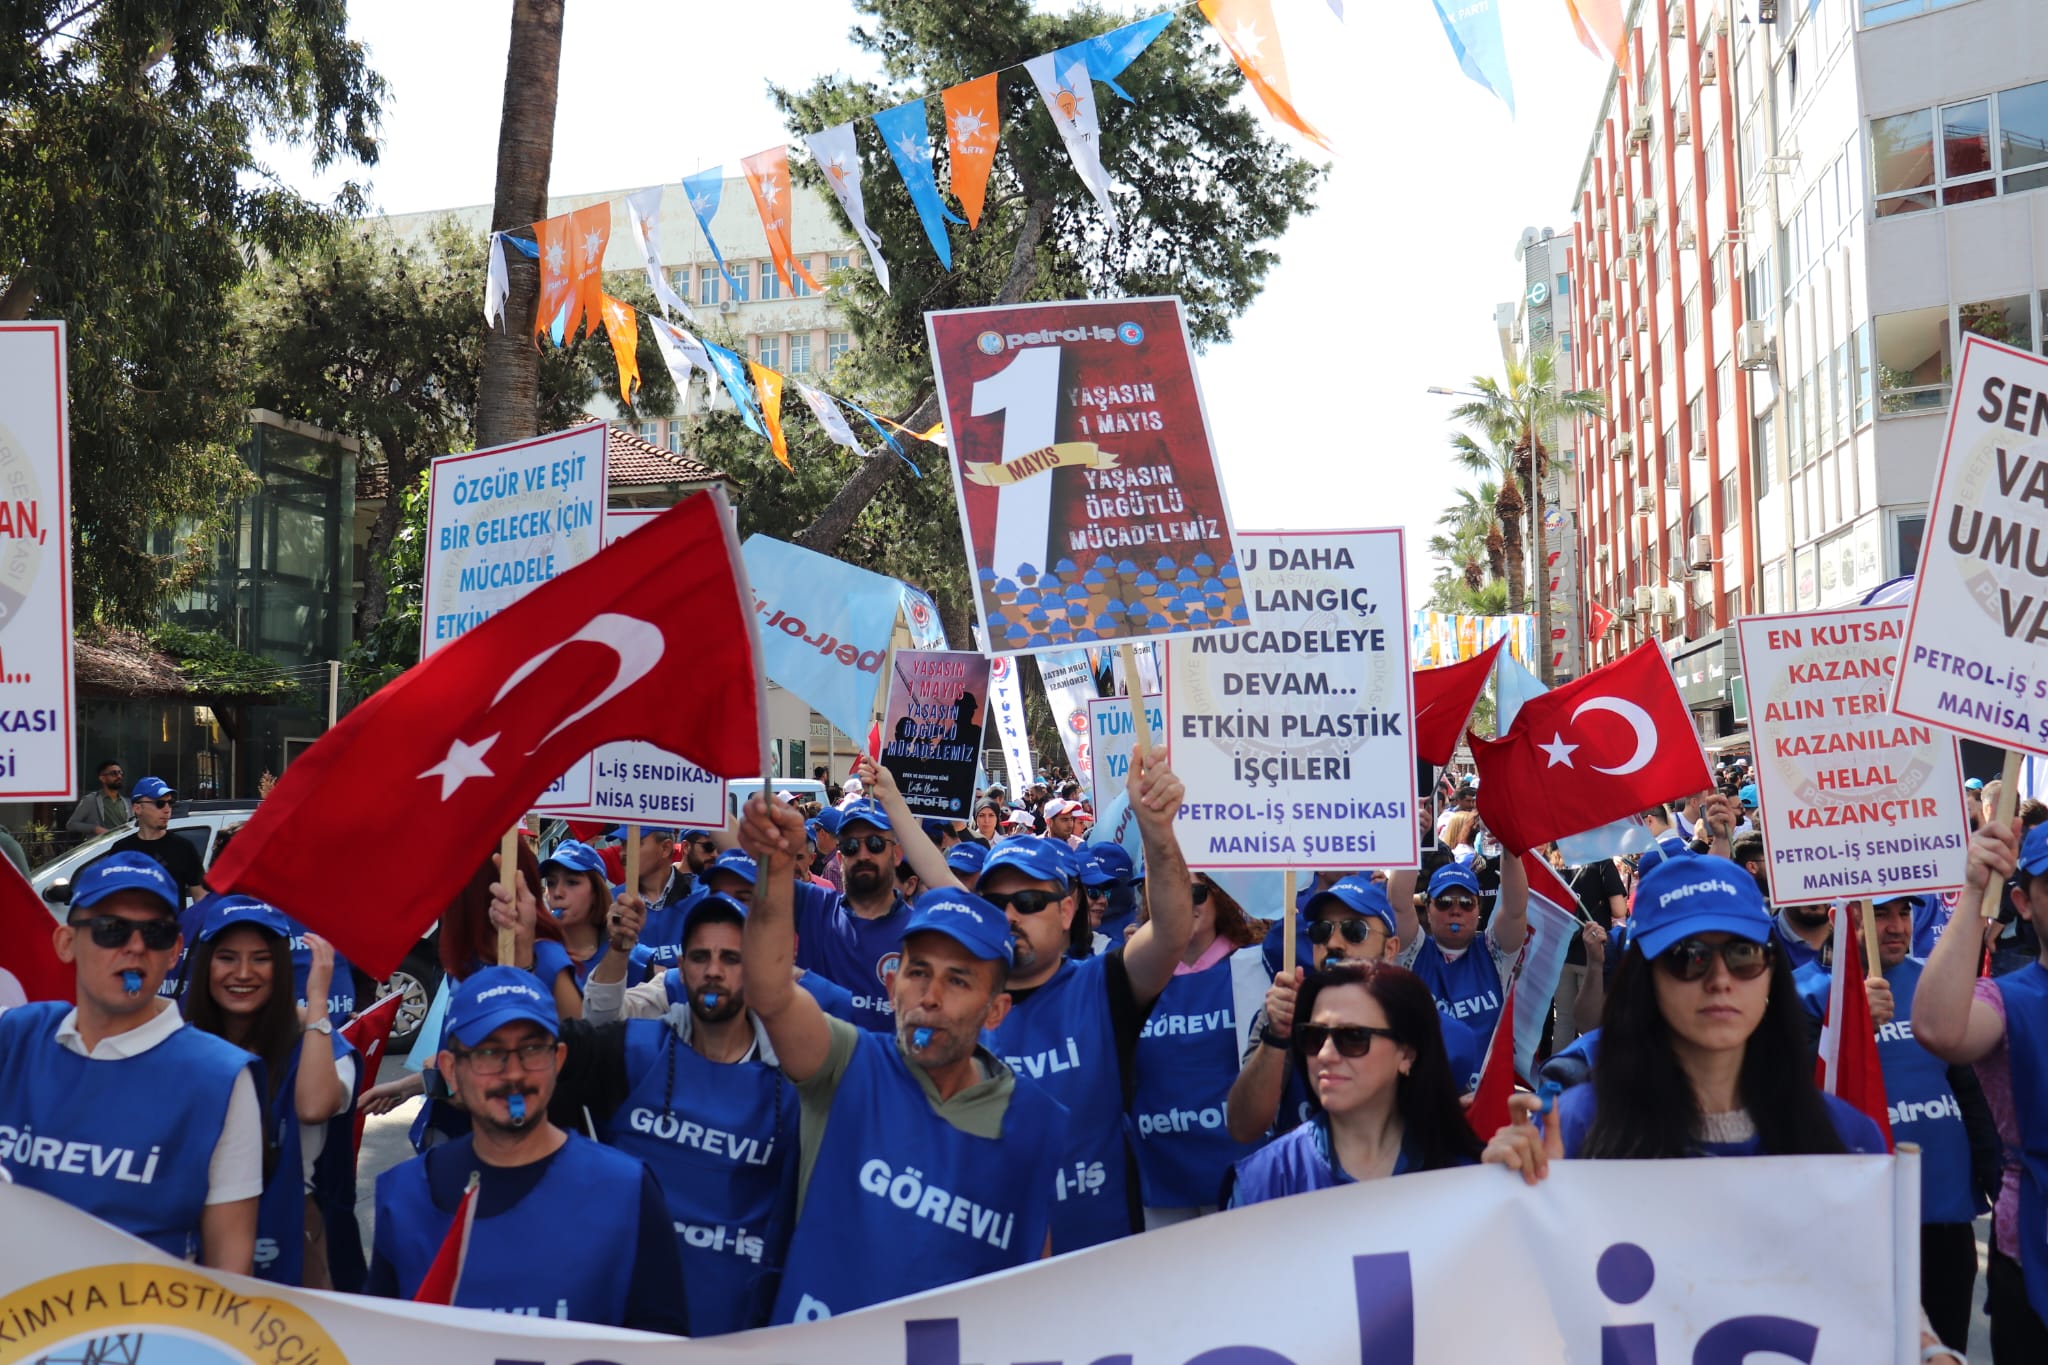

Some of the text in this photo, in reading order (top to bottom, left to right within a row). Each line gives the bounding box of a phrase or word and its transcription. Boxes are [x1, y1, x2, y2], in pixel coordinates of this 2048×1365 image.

[1005, 325, 1116, 350] petrol-iş
[1068, 384, 1156, 411] YAŞASIN
[1078, 411, 1163, 435] 1 MAYIS
[453, 450, 586, 506] ÖZGÜR VE EŞİT
[1005, 447, 1061, 482] MAYIS
[1083, 465, 1174, 493] YAŞASIN
[1086, 489, 1184, 519] ÖRGÜTLÜ
[440, 499, 593, 551] BİR GELECEK İÇİN
[1069, 515, 1221, 551] MÜCADELEMİZ
[1269, 548, 1355, 571] DAHA
[1767, 629, 1802, 650] EN
[914, 661, 965, 677] YAŞASIN
[1223, 672, 1356, 695] DEVAM...
[1913, 646, 2028, 699] PETROL-İŞ
[919, 681, 965, 700] MAYIS
[1764, 688, 1887, 722] ALIN TERİ
[1182, 707, 1402, 738] ETKİN PLASTİK
[1937, 692, 2031, 733] MANİSA
[1775, 727, 1932, 757] KAZANILAN
[632, 762, 719, 784] SENDİKASI
[1234, 750, 1351, 787] İŞÇİLERİ
[1817, 766, 1898, 790] HELAL
[639, 793, 694, 813] ŞUBESİ
[1178, 798, 1406, 824] PETROL-İŞ SENDİKASI
[1788, 797, 1938, 829] KAZANÇTIR
[1209, 831, 1376, 857] MANİSA ŞUBESİ
[1775, 834, 1962, 864] PETROL-İŞ SENDİKASI
[1803, 861, 1938, 889] MANİSA ŞUBESİ
[1660, 879, 1737, 908] petrol-iş
[859, 1158, 1015, 1251] GÖREVLİ
[0, 1285, 107, 1343] KİMYA
[119, 1281, 250, 1327] LASTİK
